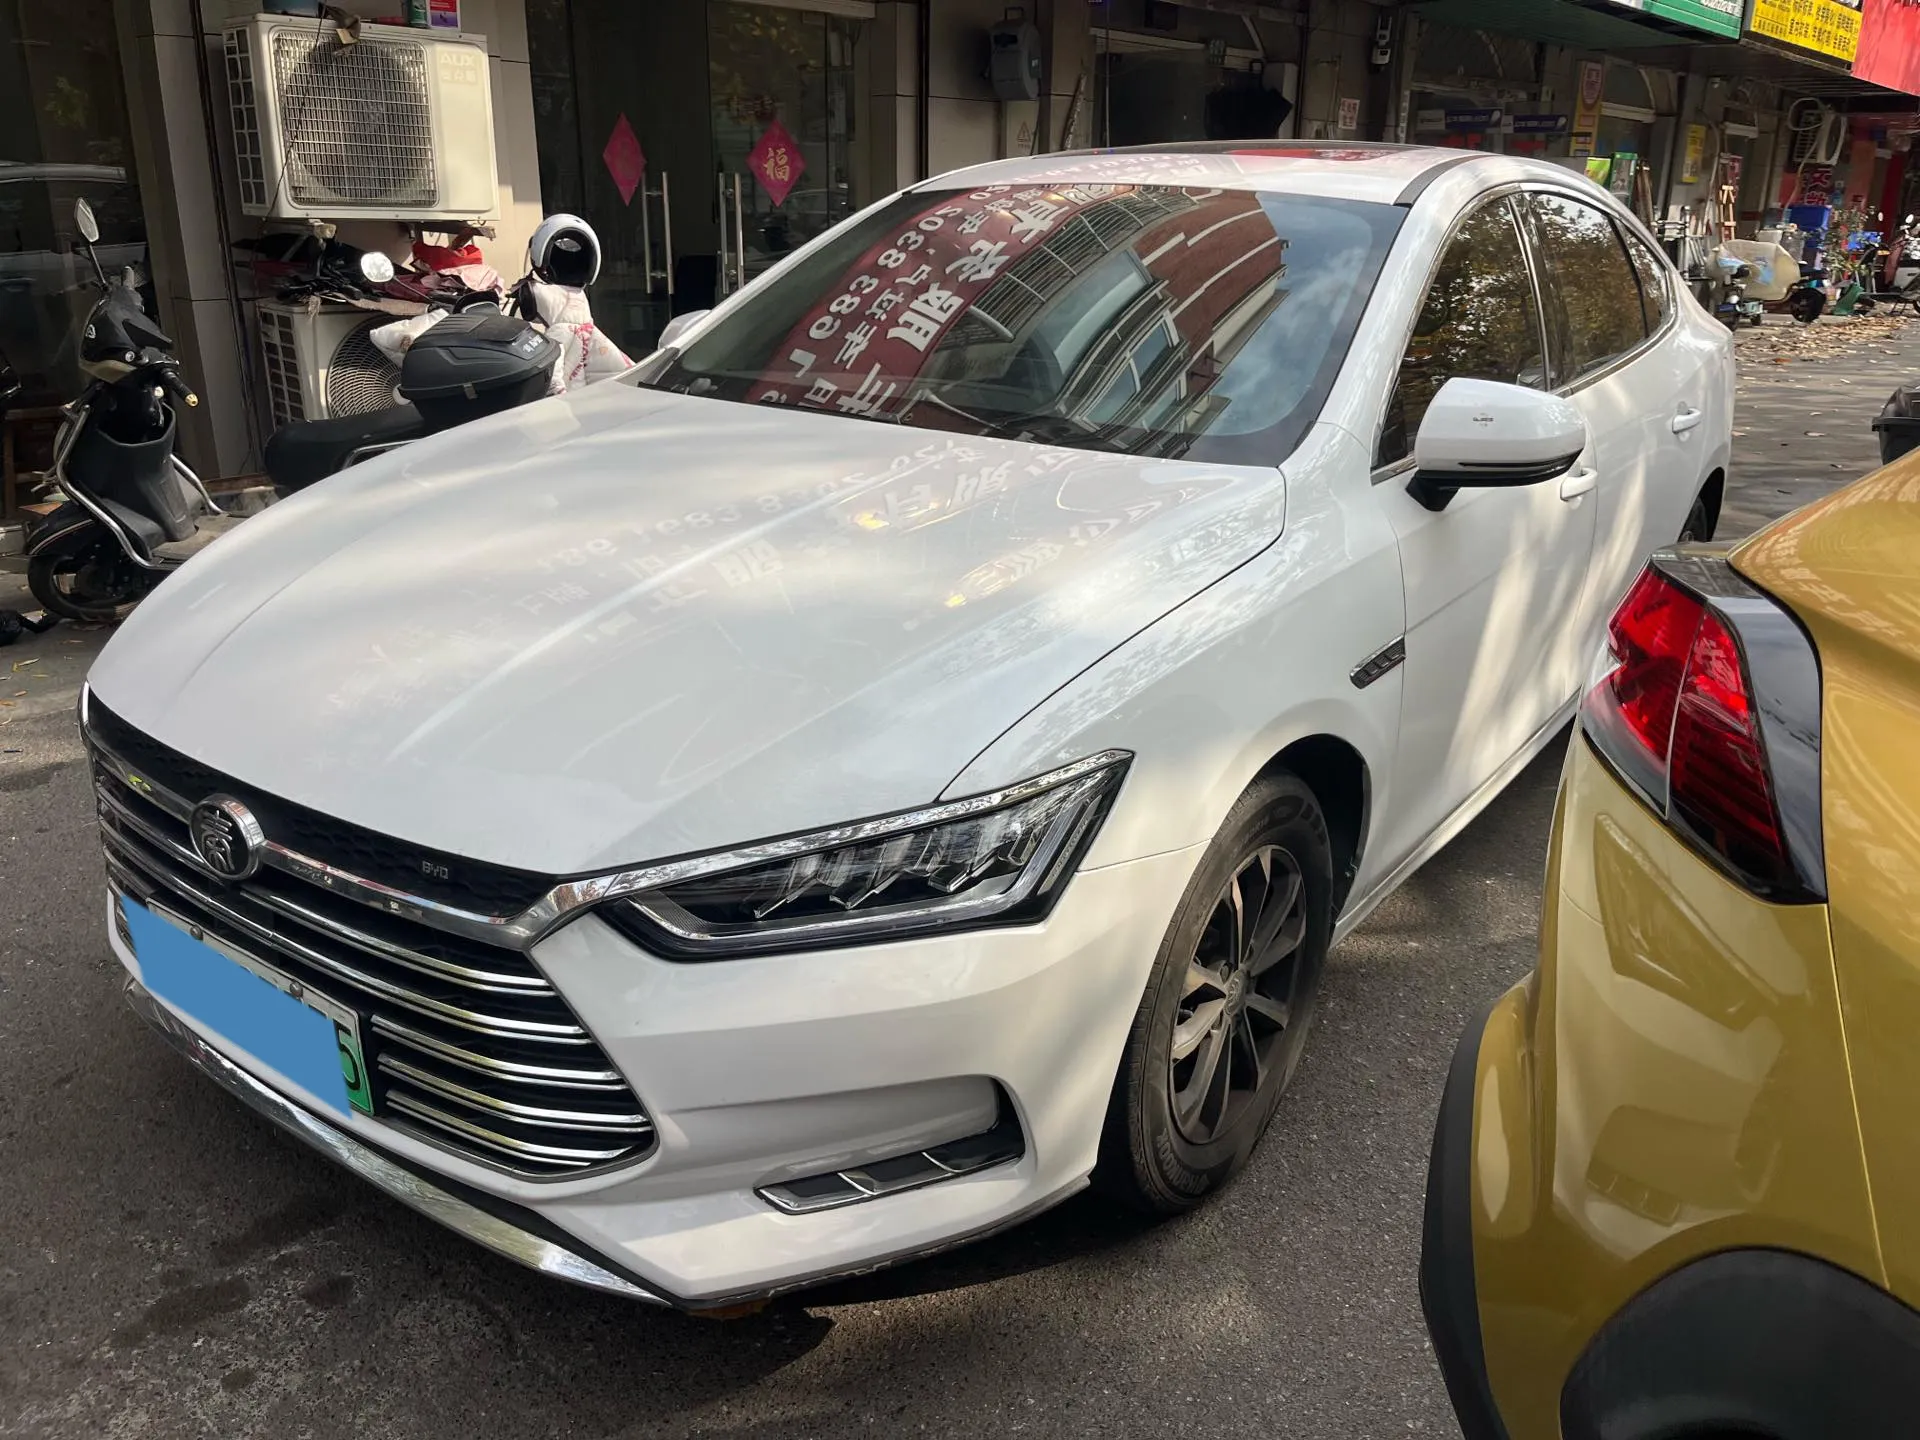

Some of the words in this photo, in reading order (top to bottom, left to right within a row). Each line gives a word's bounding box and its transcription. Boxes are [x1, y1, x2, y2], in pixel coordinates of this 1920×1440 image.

[440, 52, 475, 67] AUX
[762, 147, 790, 182] 福
[421, 860, 450, 880] BYD
